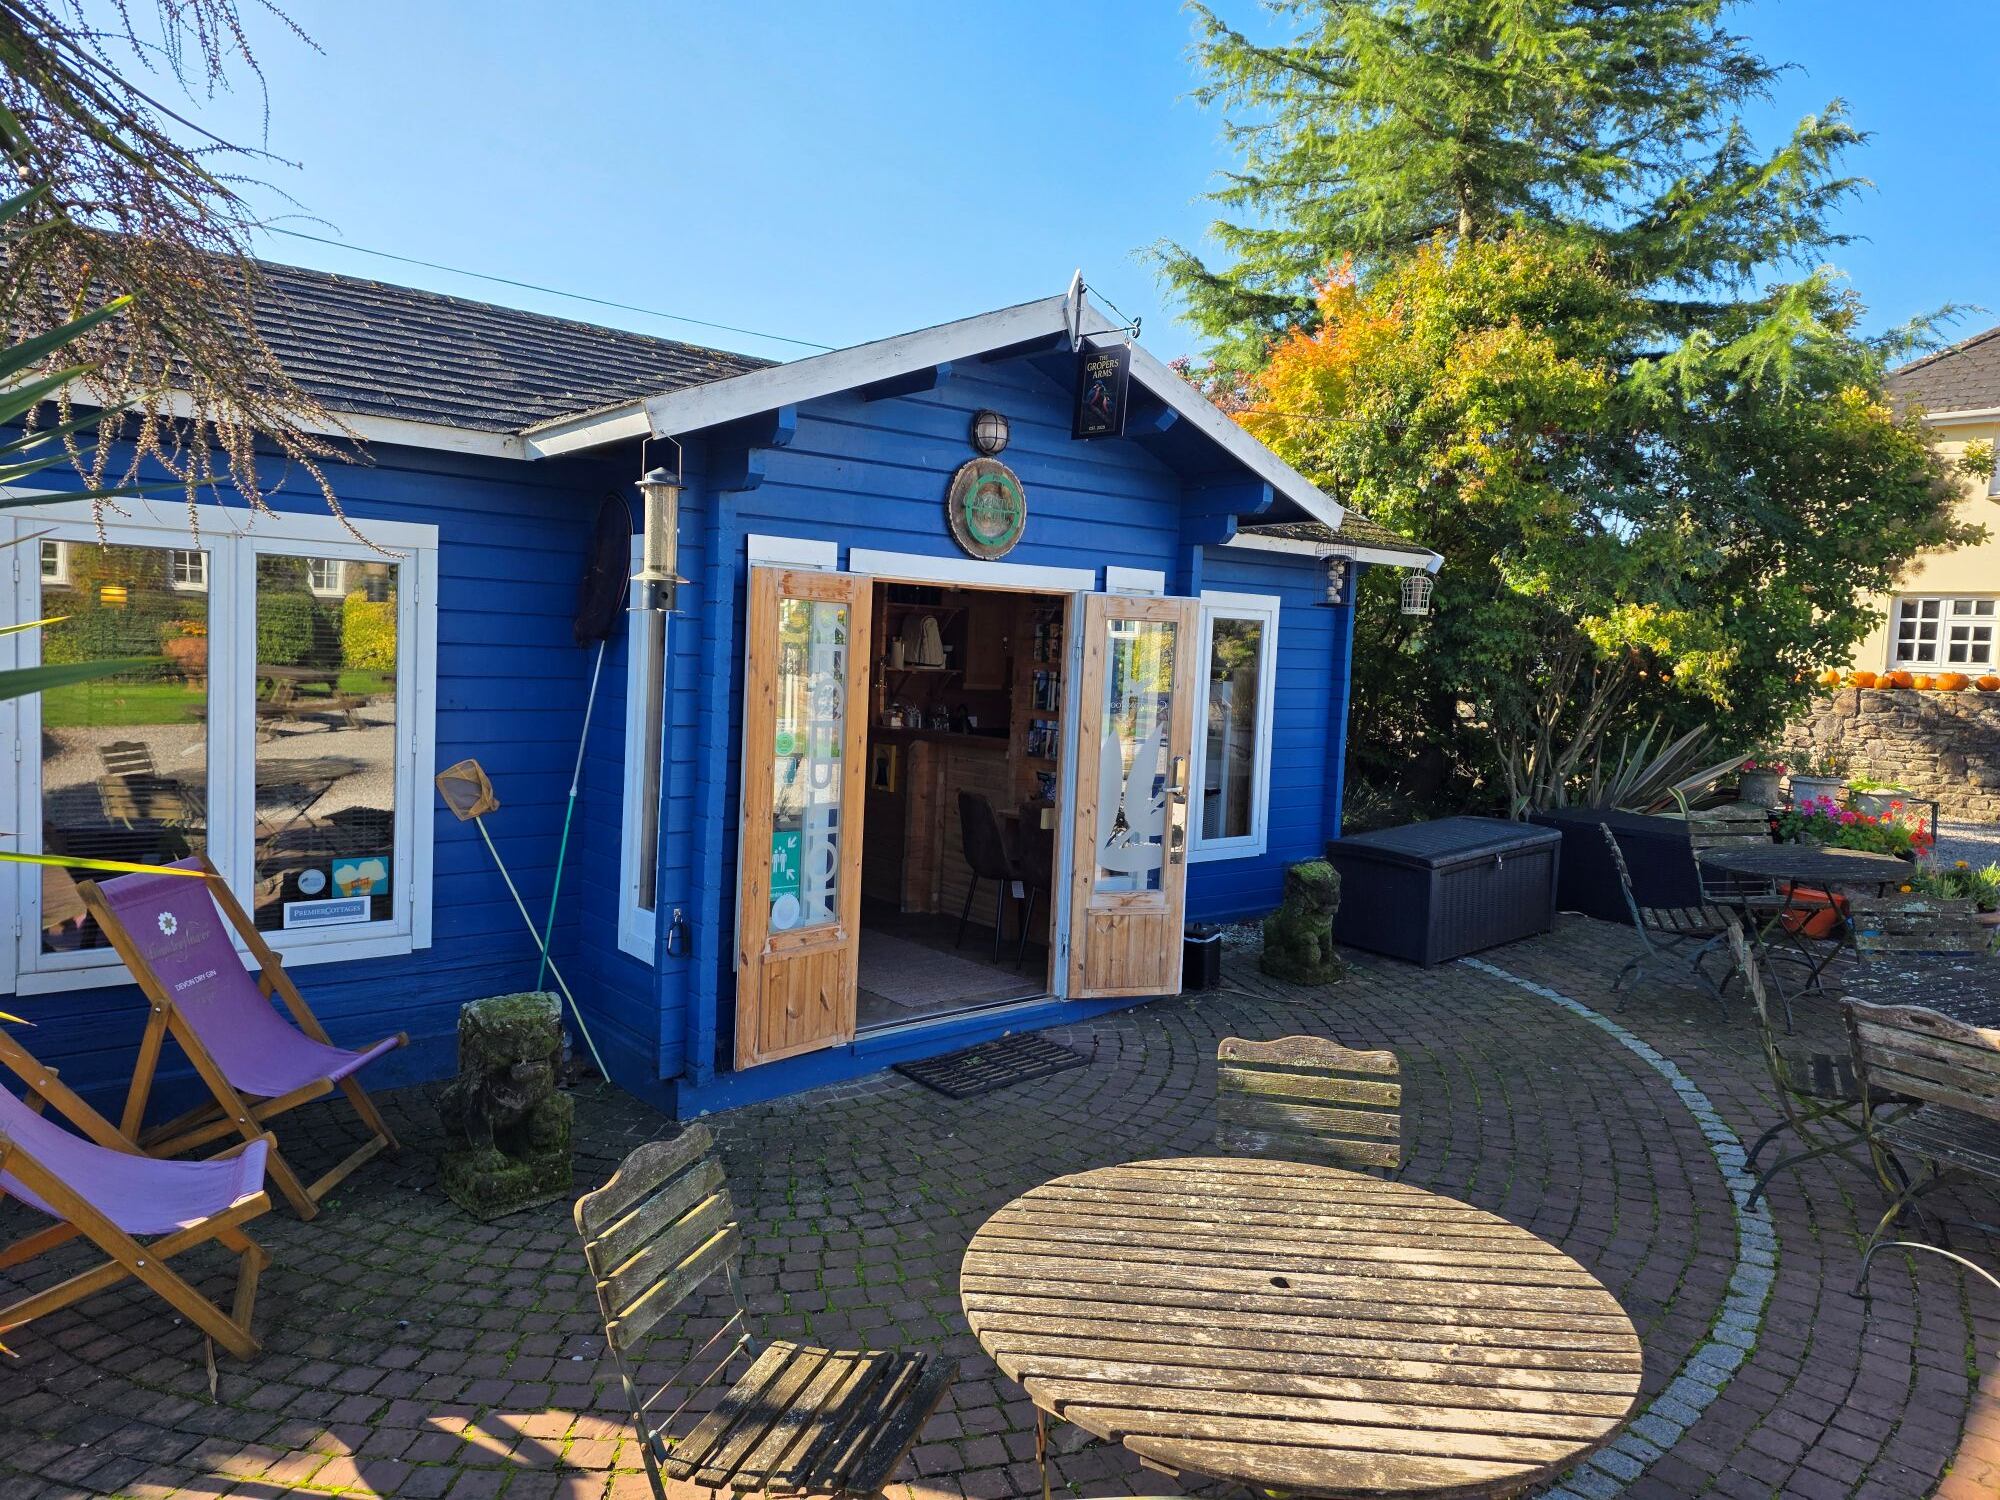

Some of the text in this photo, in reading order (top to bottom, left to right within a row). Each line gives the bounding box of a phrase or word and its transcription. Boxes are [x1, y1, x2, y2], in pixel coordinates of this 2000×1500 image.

[1087, 359, 1119, 372] GROPERS
[1093, 369, 1113, 379] ARMS
[174, 969, 217, 992] DEVON DRY GIN
